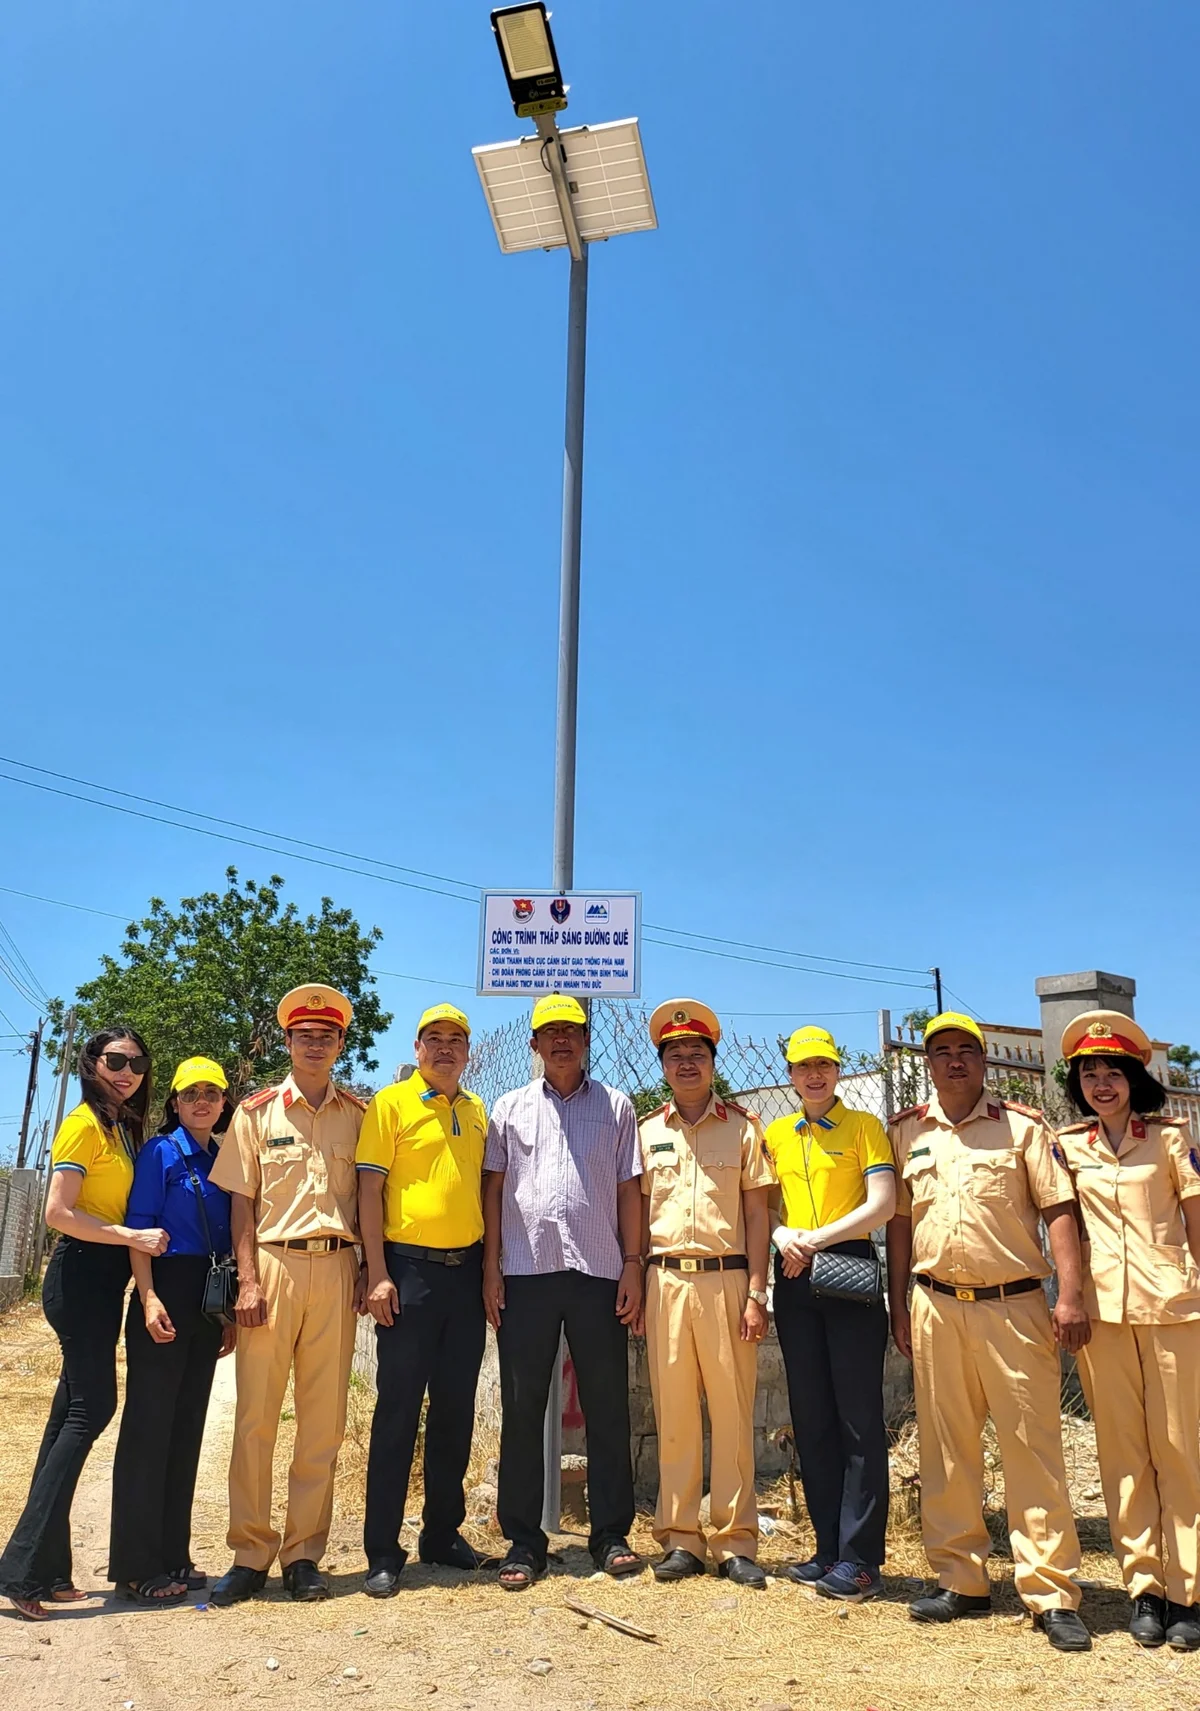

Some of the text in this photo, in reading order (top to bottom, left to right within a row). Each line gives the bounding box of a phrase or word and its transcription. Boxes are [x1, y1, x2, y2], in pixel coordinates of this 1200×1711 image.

[492, 925, 629, 946] CÔNG TRÌNH THẮP SÁNG ĐƯỜNG QUÊ
[506, 957, 522, 965] THANH
[571, 957, 583, 965] GIAO
[492, 968, 500, 976] CHI
[534, 980, 544, 988] NAM
[554, 980, 562, 988] CHI
